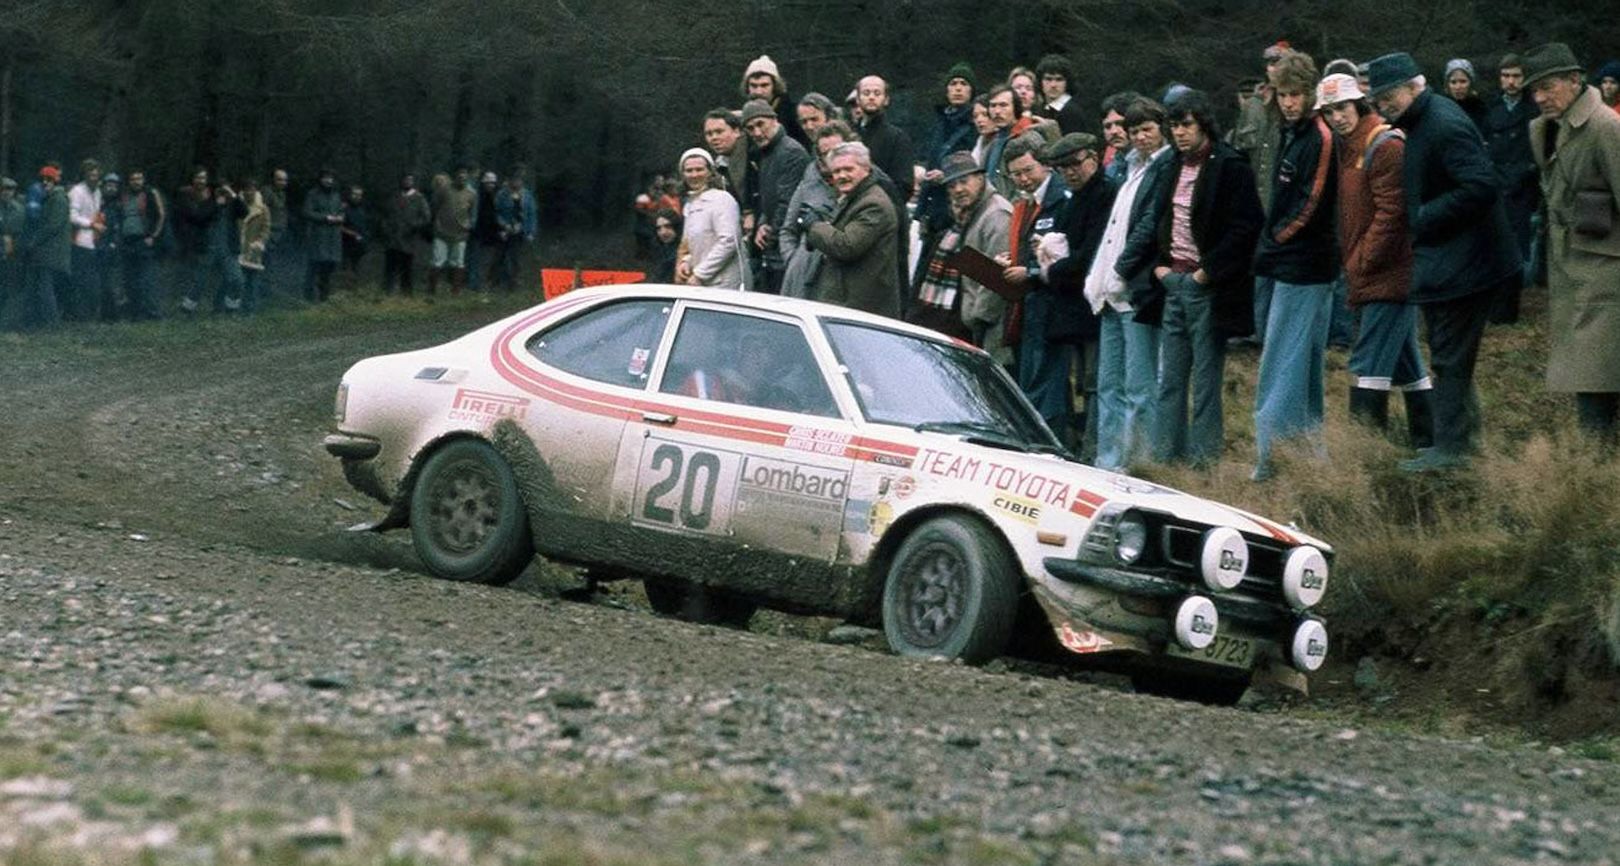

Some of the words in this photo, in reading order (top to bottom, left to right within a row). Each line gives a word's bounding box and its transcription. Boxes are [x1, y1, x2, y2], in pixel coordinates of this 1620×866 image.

[452, 387, 530, 420] PIRELLI
[643, 443, 721, 530] 20
[739, 457, 849, 499] Lombard
[920, 449, 982, 482] TEAM
[985, 463, 1071, 509] TOYOTA
